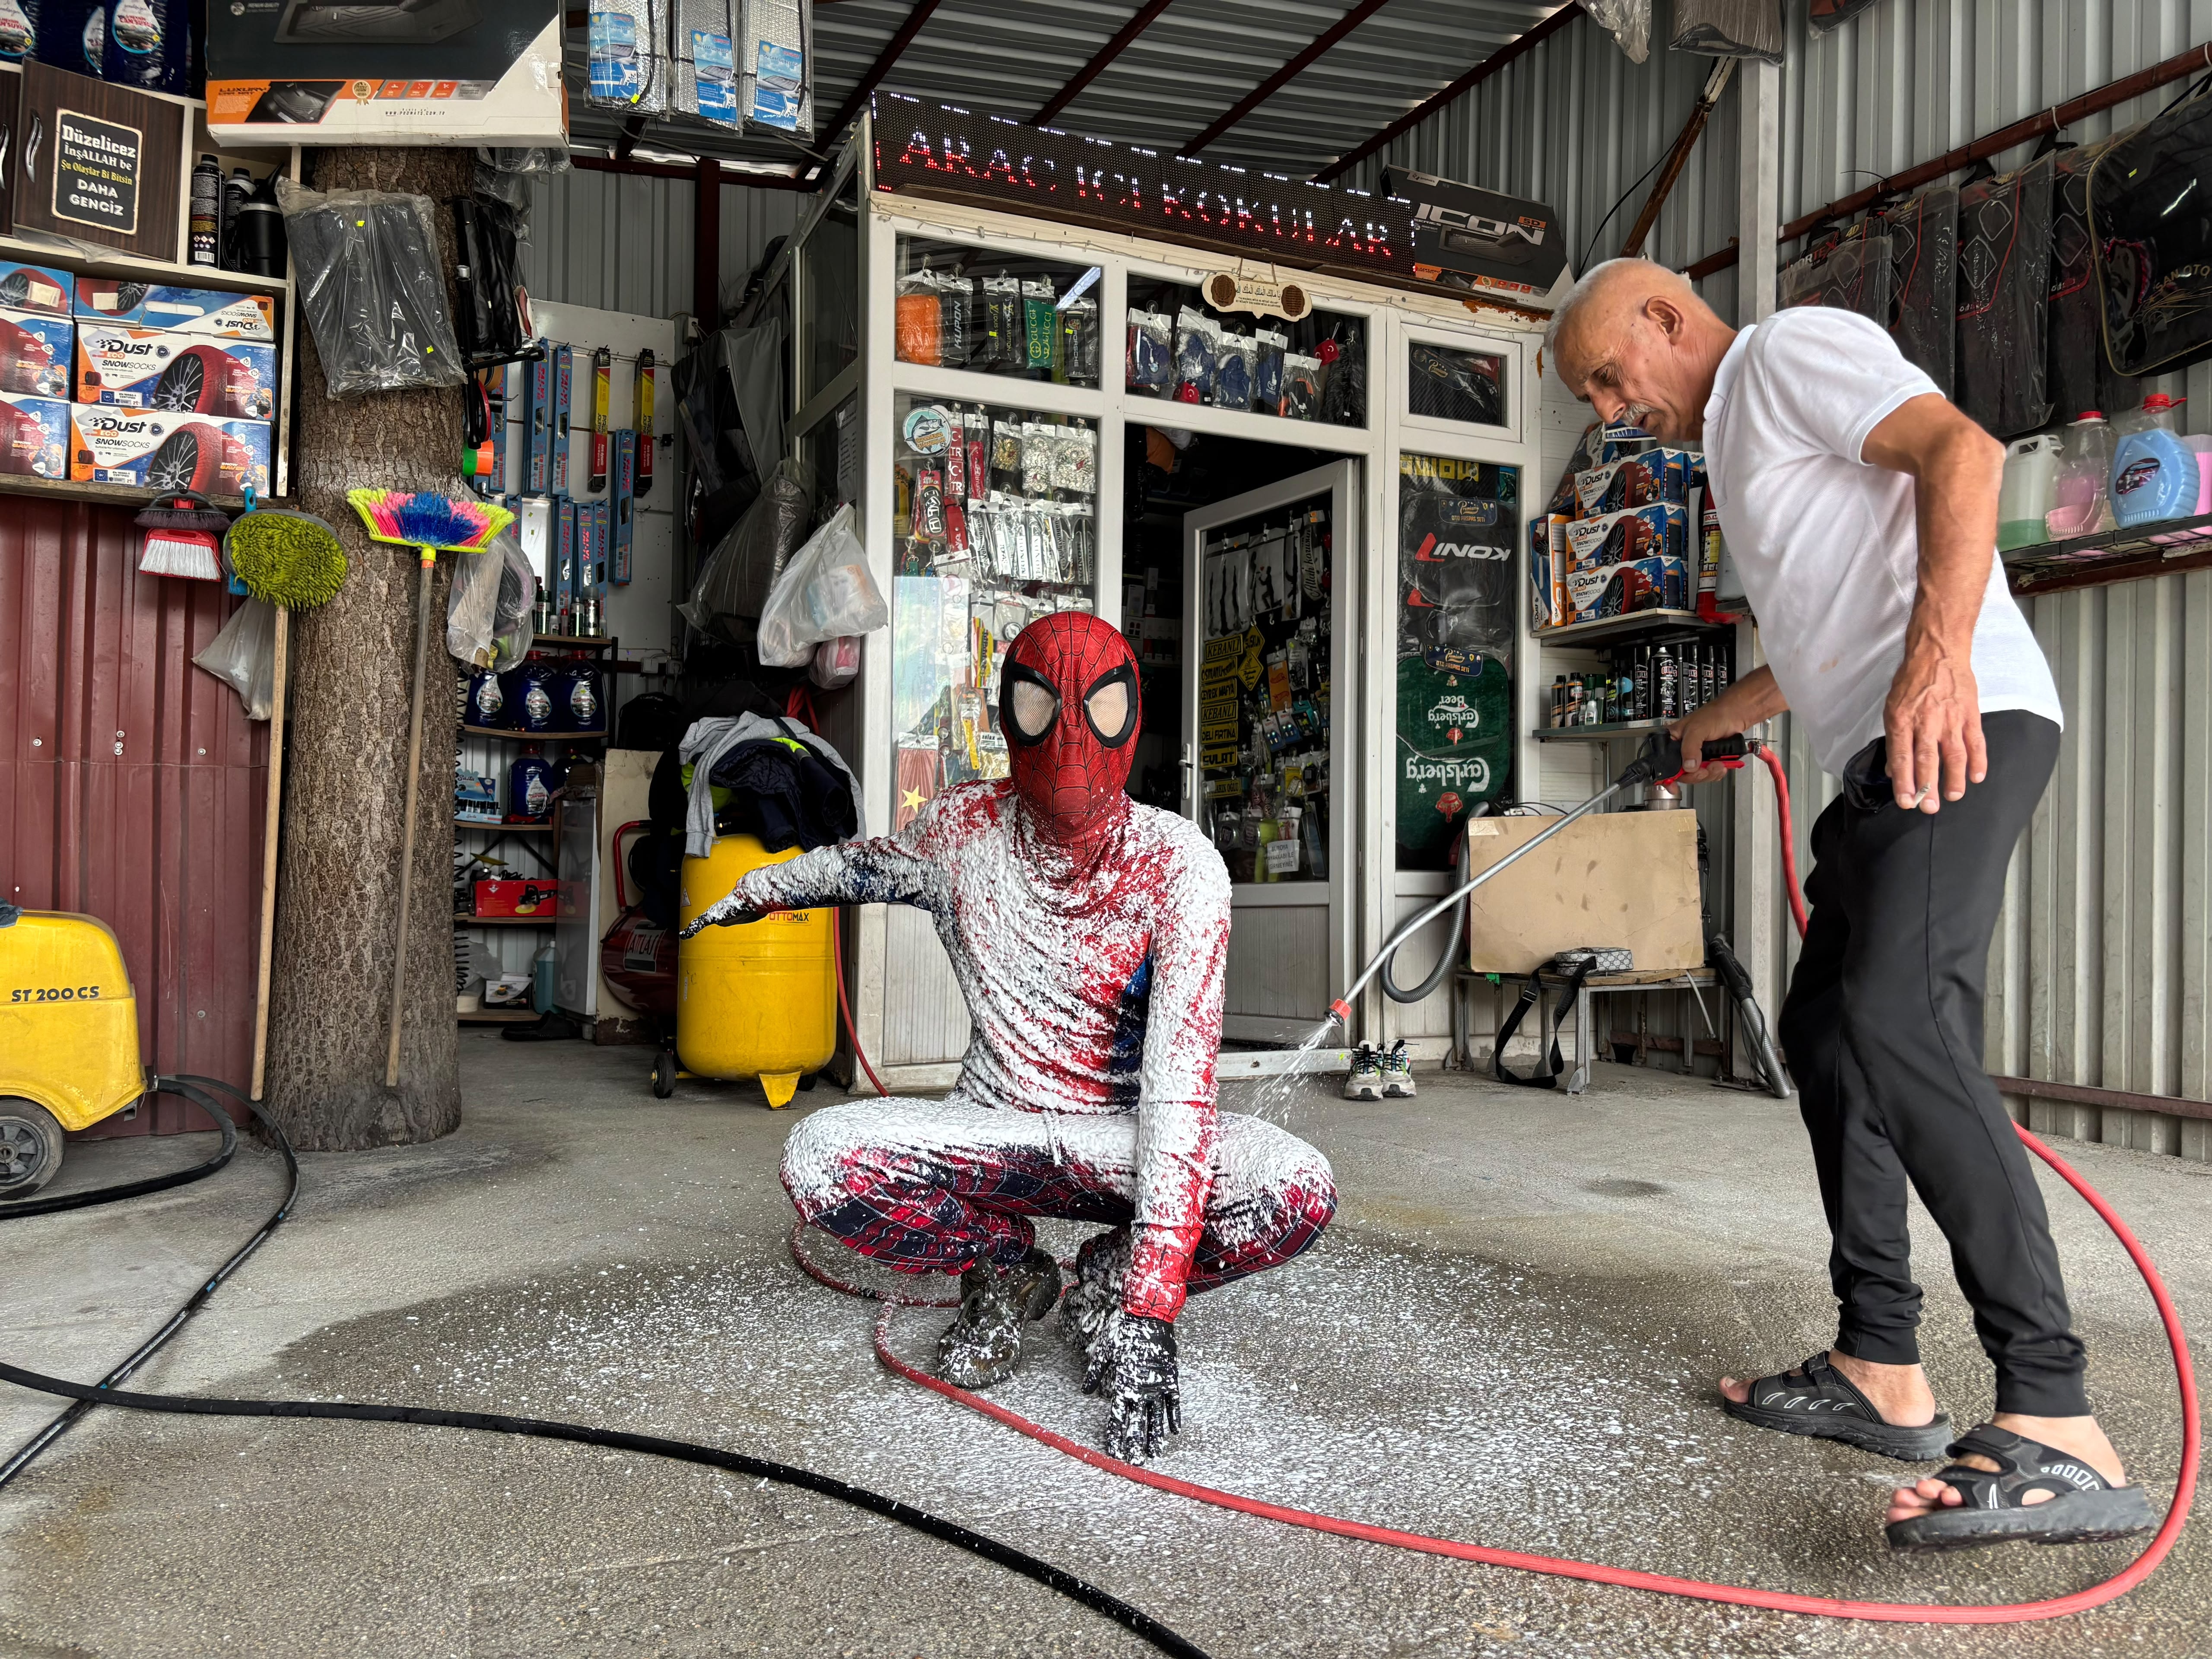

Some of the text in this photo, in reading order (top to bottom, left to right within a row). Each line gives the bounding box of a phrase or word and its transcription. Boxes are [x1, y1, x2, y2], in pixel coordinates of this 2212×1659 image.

[62, 124, 136, 158] Düzelicez
[120, 159, 132, 170] be
[61, 159, 132, 185] Şu Olaylar Bi Bitsin
[77, 178, 118, 199] DAHA
[1163, 184, 1391, 256] KOKULAR
[1414, 203, 1545, 245] ICON
[1845, 224, 1860, 238] 4D
[108, 339, 153, 355] Dust
[102, 360, 156, 370] SNOWSOCKS
[101, 417, 147, 433] Dust
[95, 438, 150, 448] SNOWSOCKS
[950, 447, 962, 457] TR
[1586, 473, 1603, 485] Dust
[951, 481, 963, 492] TR
[1583, 485, 1605, 496] SNOWSOCKS
[1579, 524, 1601, 536] Dust
[977, 519, 987, 559] Volkwagen
[1054, 521, 1065, 560] Volkswagen
[1576, 537, 1602, 546] SNOWSOCKS
[1433, 542, 1512, 561] KONI
[1303, 567, 1321, 598] Allah
[1578, 575, 1599, 586] Dust
[1576, 588, 1601, 597] SNOWSOCKS
[1439, 695, 1465, 708] Beer
[1428, 707, 1479, 728] Carlsberg
[1203, 752, 1234, 765] EVLAT
[1406, 754, 1490, 792] Carlsberg
[1227, 781, 1239, 792] OĞLU
[1222, 828, 1231, 841] FIAT
[769, 912, 809, 922] OTTOMAX
[12, 986, 99, 1002] ST 200 CS
